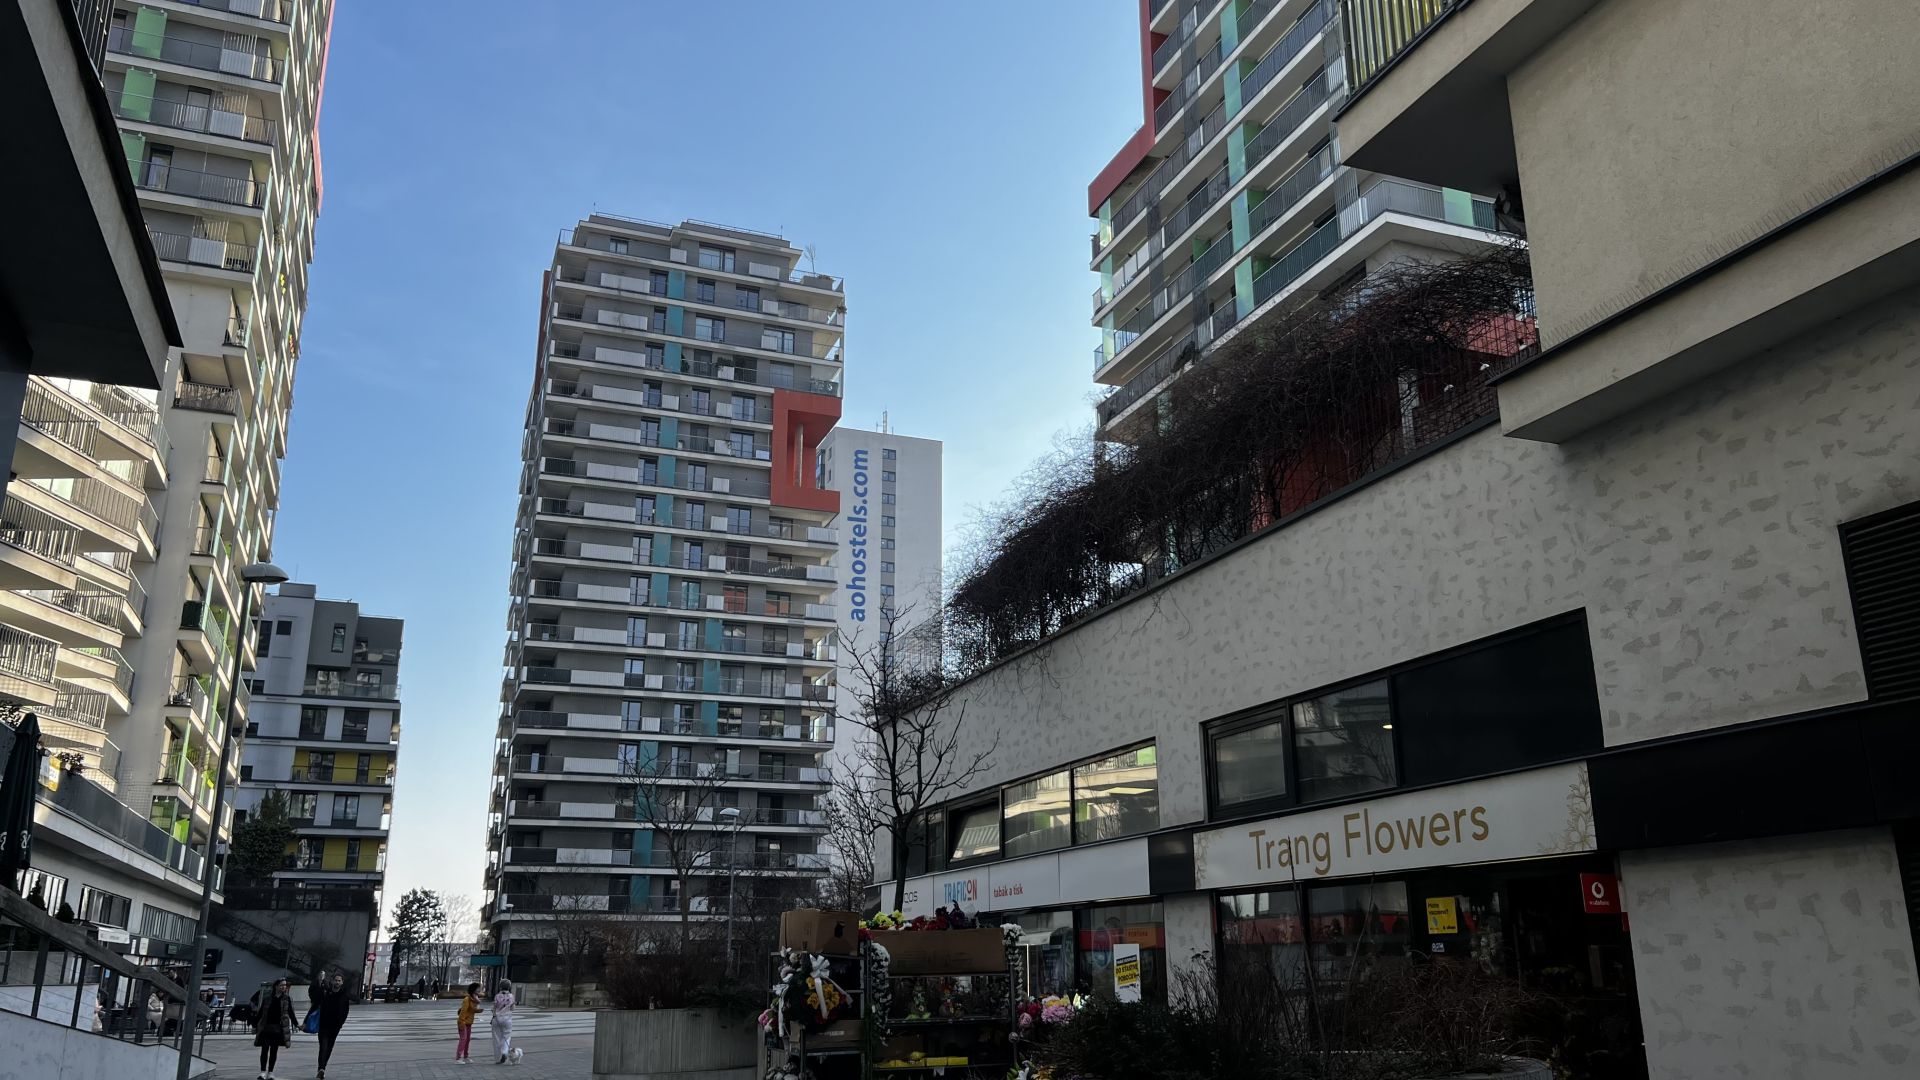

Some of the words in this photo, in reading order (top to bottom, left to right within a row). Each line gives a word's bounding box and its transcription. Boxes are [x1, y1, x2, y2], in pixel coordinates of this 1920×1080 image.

[846, 449, 869, 622] aohostels.com
[1249, 829, 1331, 875] Trang
[1343, 806, 1489, 858] Flowers
[904, 891, 918, 904] QOS
[944, 880, 977, 904] TRAFICON
[1009, 887, 1013, 896] a
